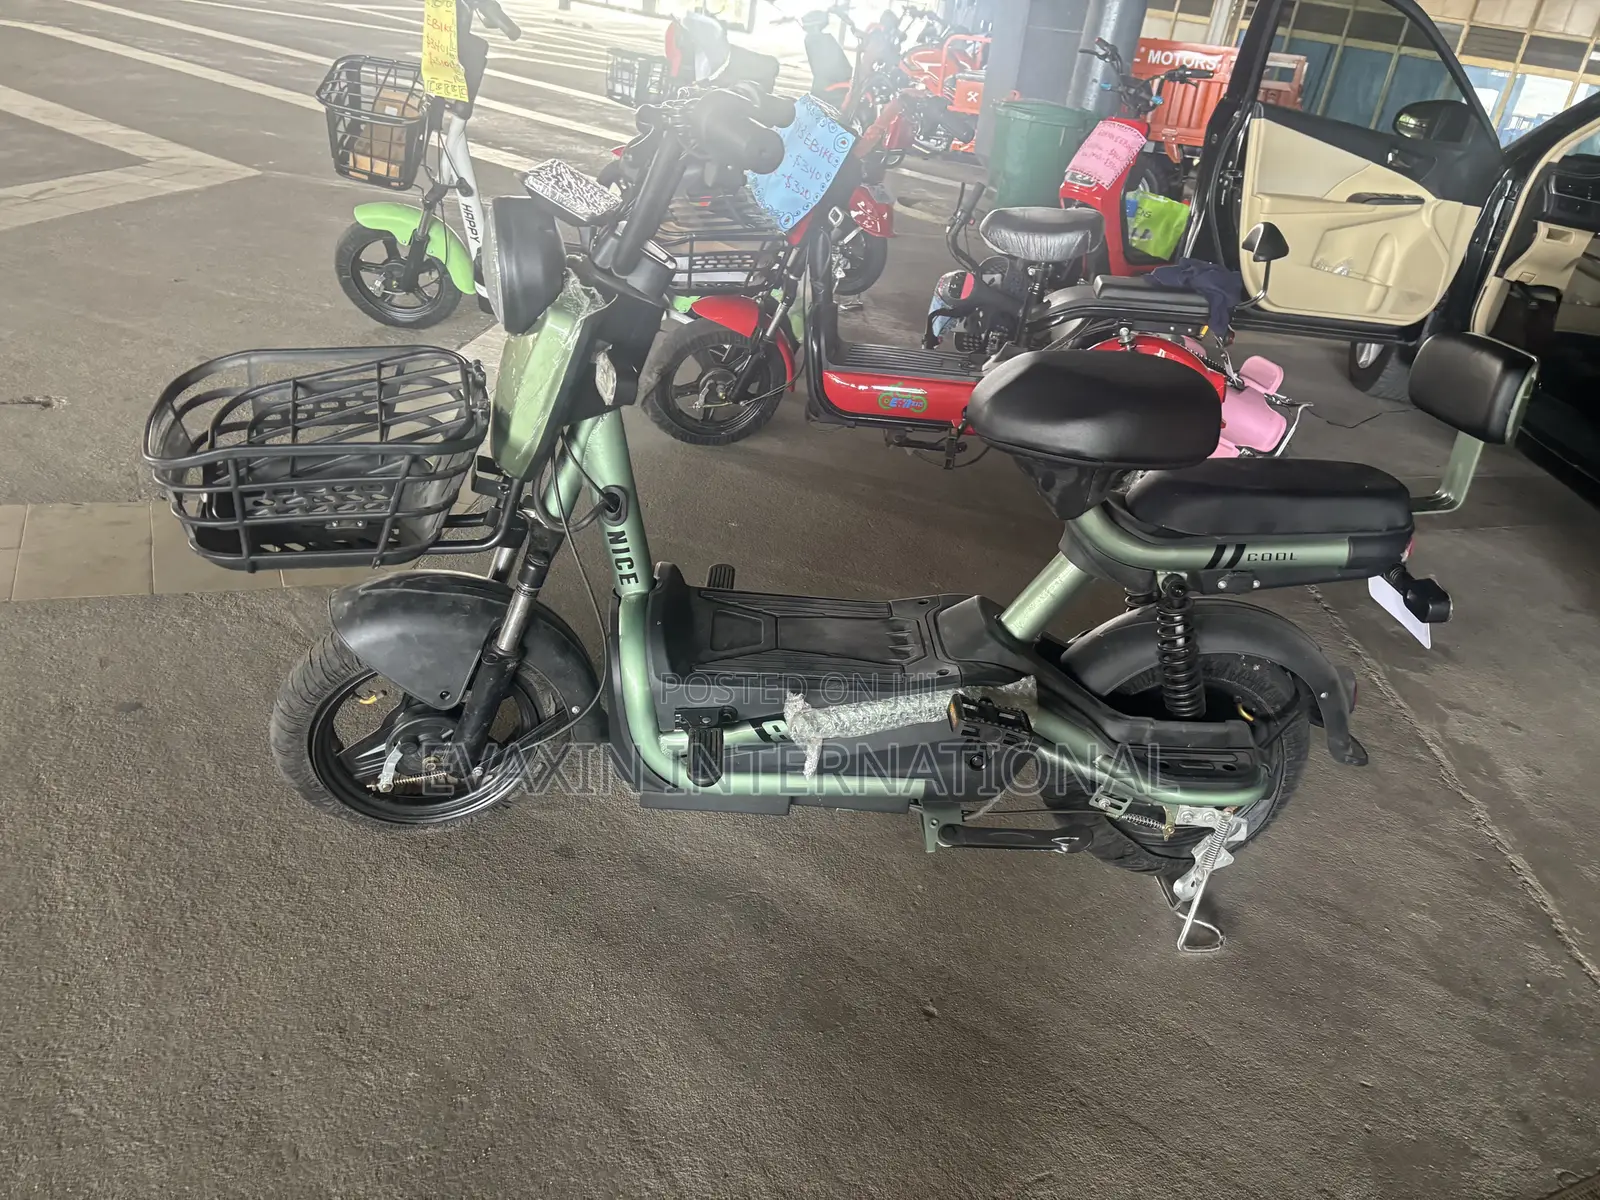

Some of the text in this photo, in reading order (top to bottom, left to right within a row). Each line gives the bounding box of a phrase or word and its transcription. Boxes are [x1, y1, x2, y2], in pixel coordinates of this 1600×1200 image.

[1148, 50, 1218, 70] MOTORS
[461, 202, 481, 244] HAPPY
[606, 530, 640, 586] NICE
[1247, 552, 1297, 562] COOL
